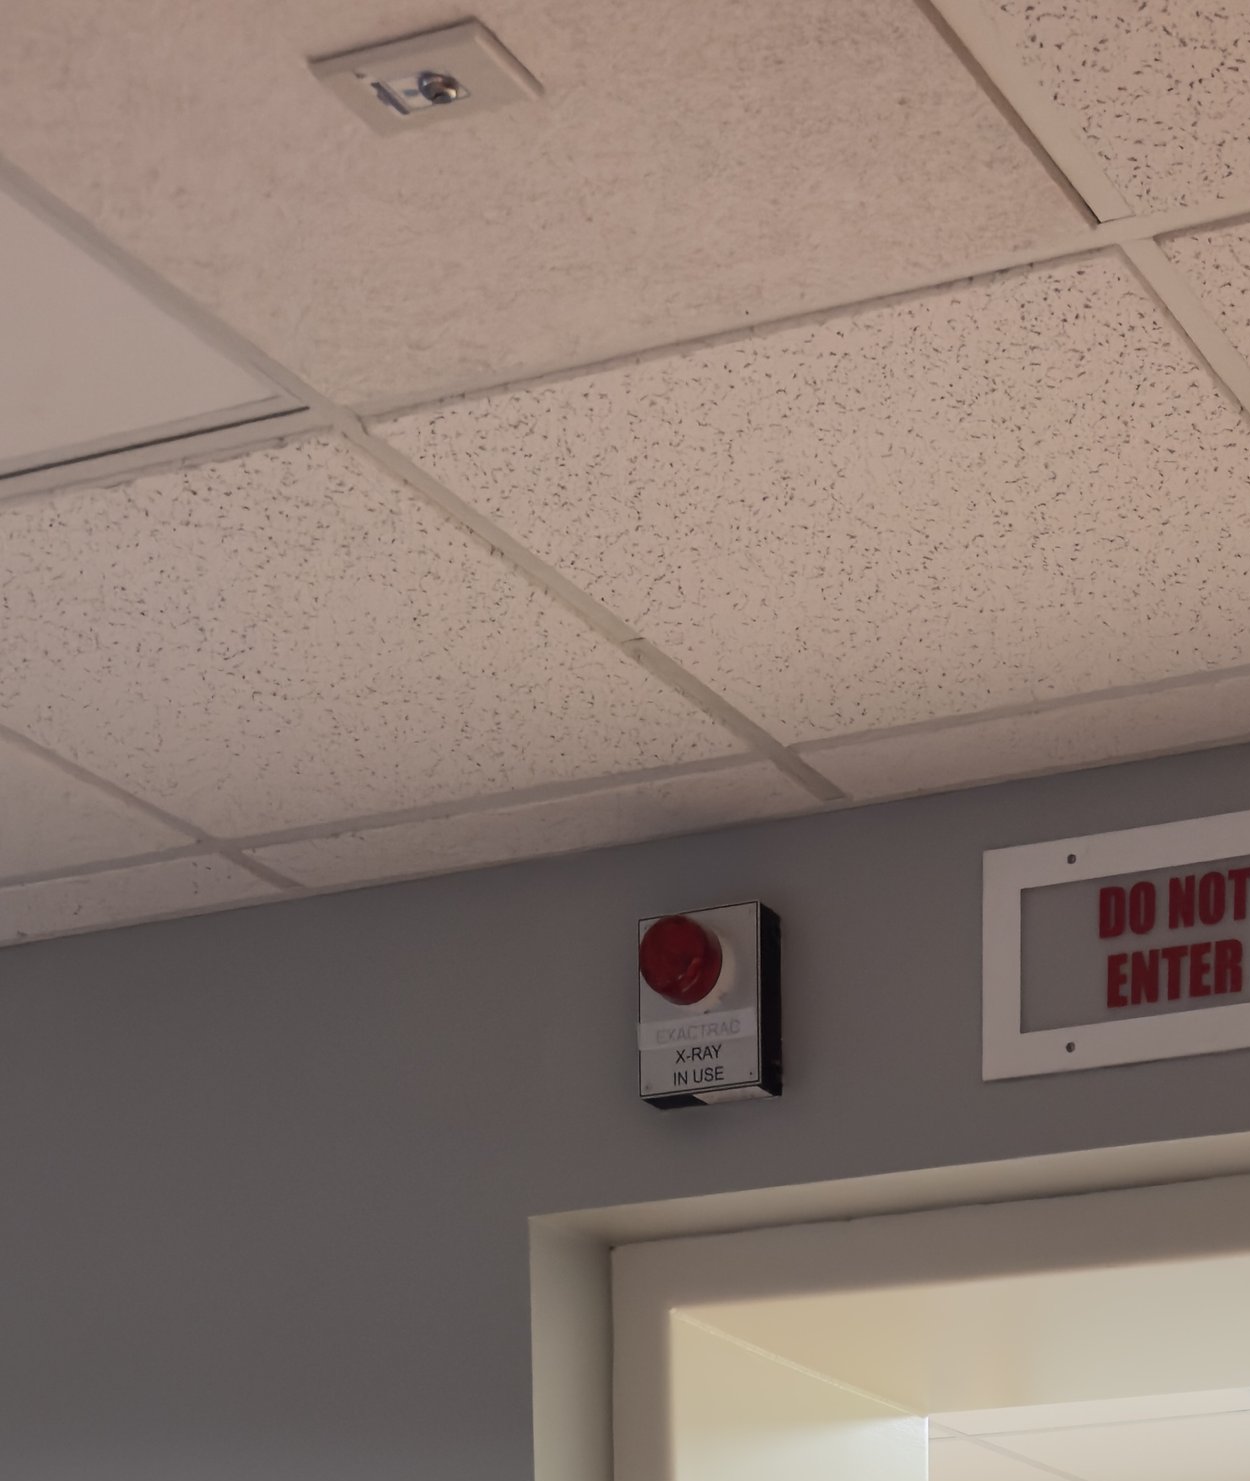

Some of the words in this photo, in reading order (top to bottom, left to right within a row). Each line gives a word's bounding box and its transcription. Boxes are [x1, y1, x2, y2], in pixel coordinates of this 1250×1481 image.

[1099, 886, 1156, 939] DO
[1107, 938, 1243, 1008] ENTER
[676, 1044, 722, 1064] X-RAY
[674, 1071, 688, 1086] IN
[693, 1066, 724, 1083] USE
